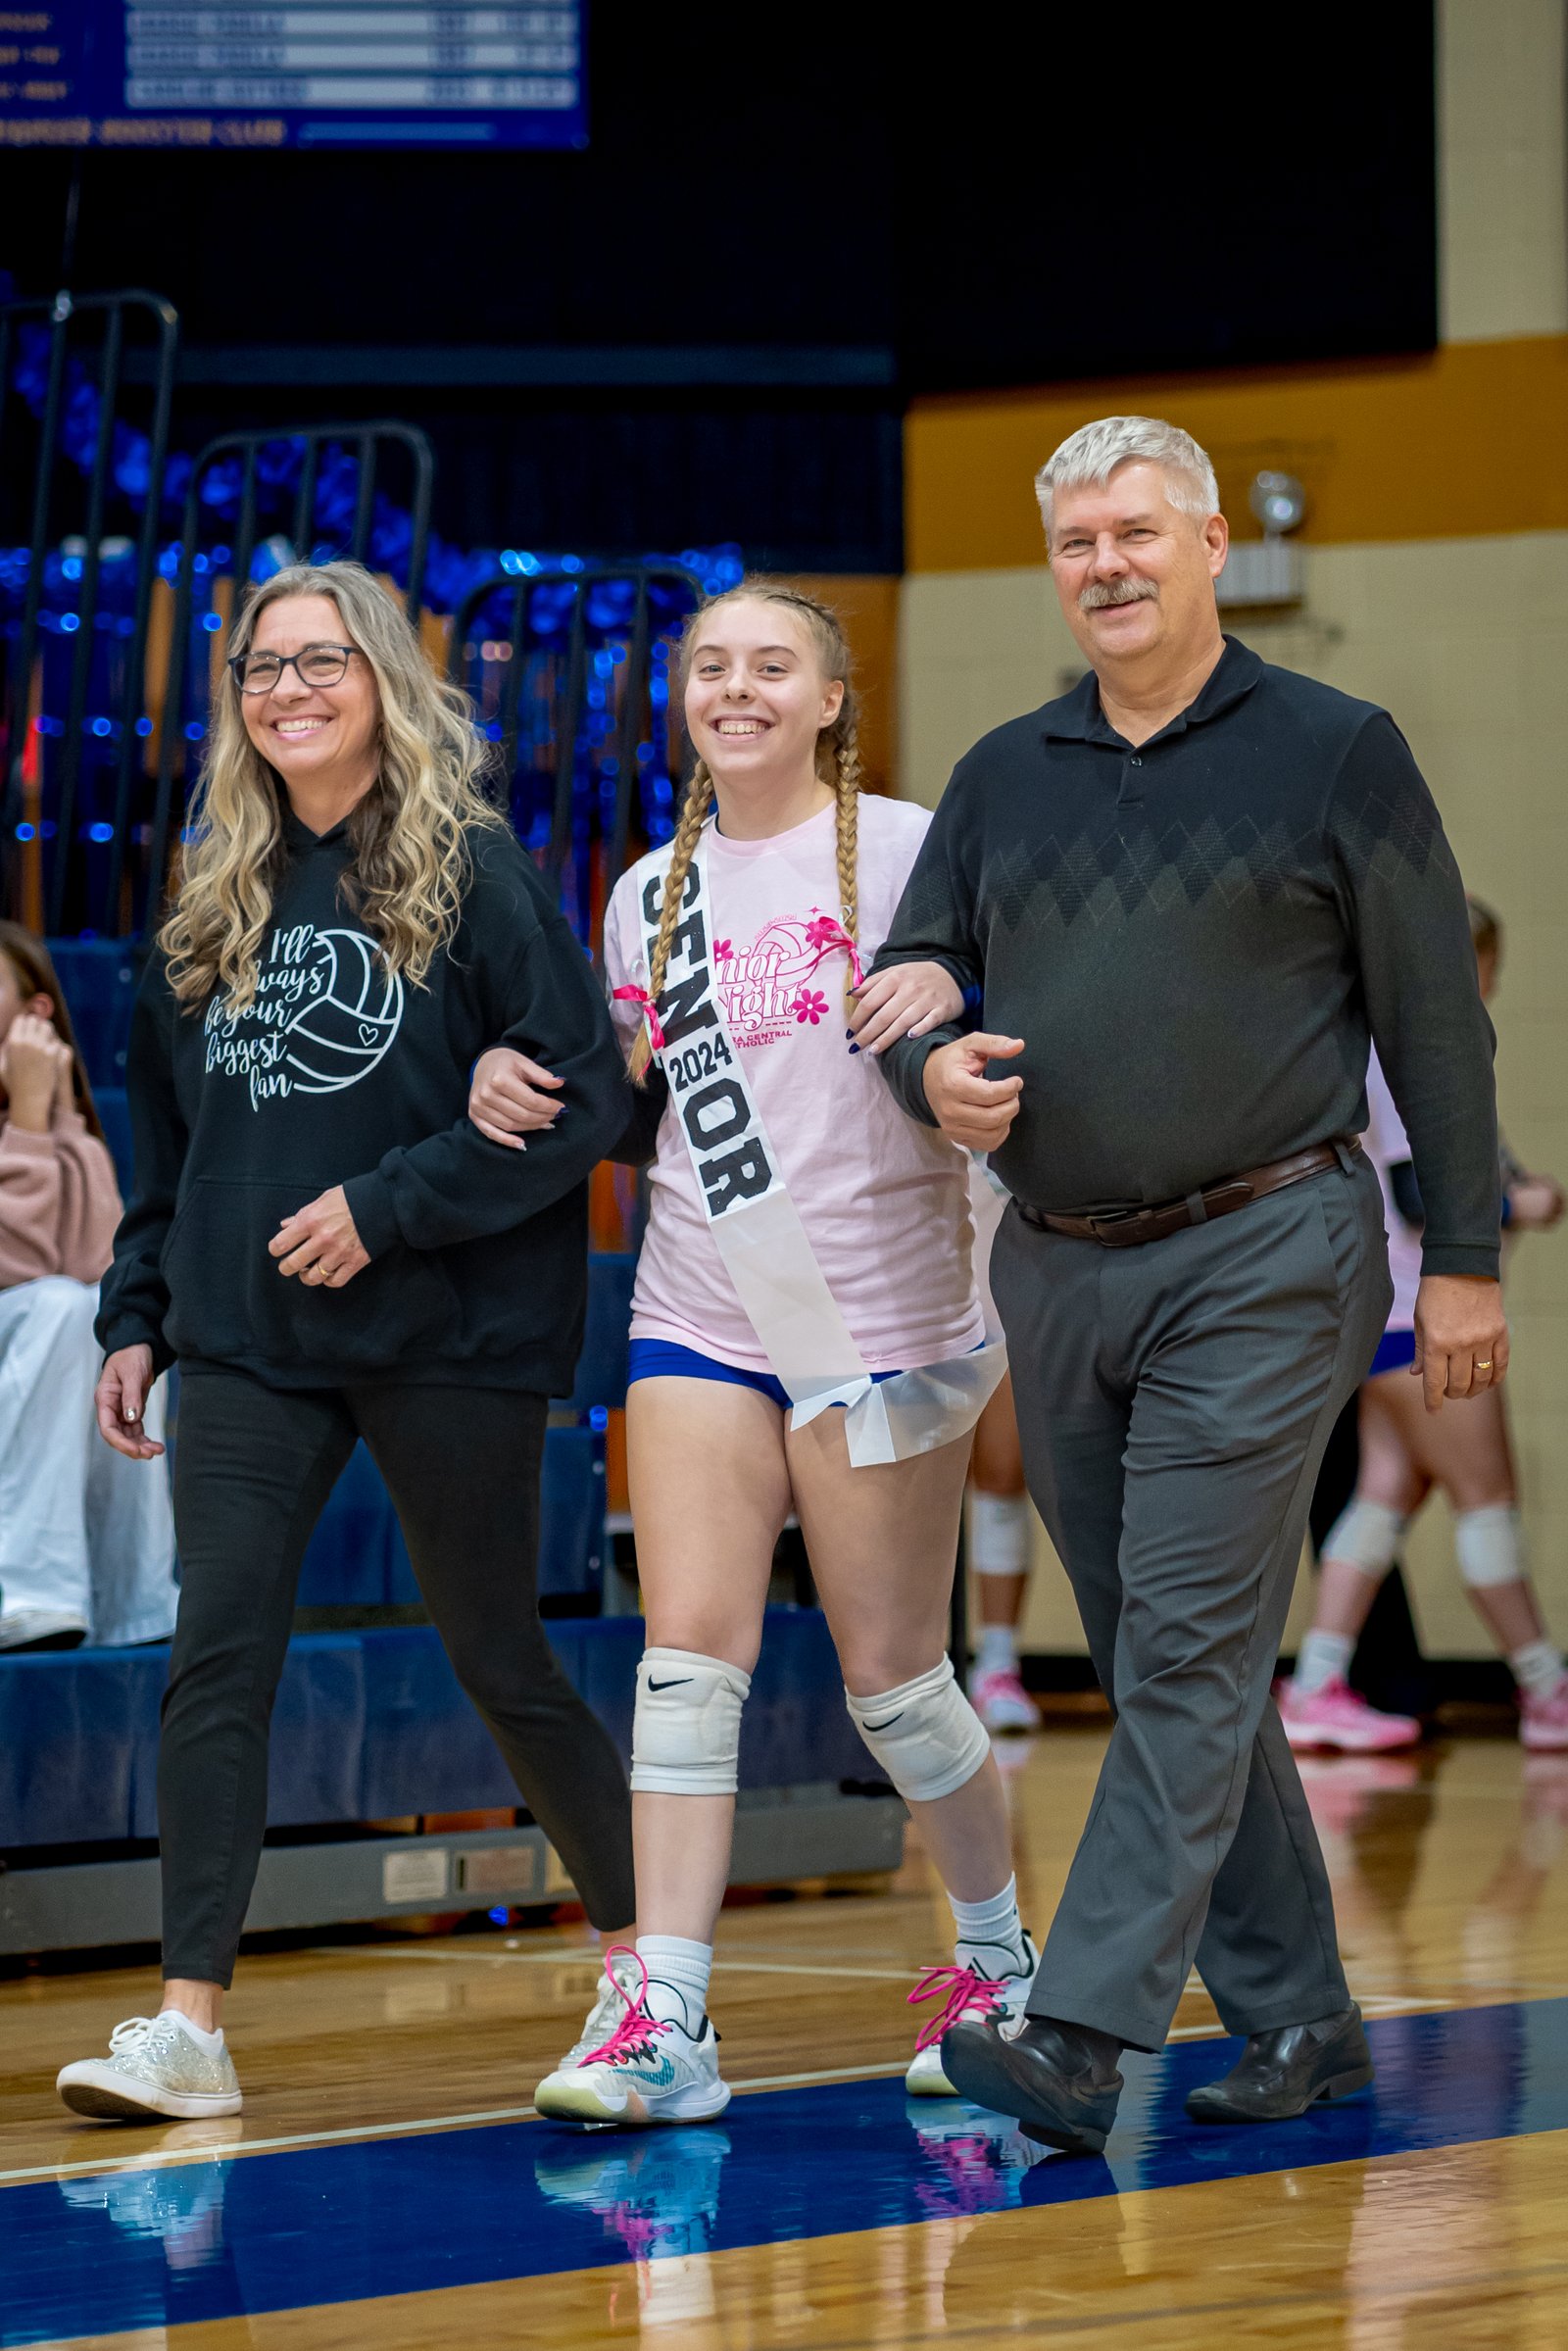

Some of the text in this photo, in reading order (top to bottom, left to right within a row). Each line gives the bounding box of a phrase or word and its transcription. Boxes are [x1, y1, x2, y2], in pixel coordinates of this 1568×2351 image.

[269, 924, 314, 964] I'll
[232, 959, 324, 1003] ways
[715, 946, 791, 984] nior
[221, 1000, 292, 1038] your
[747, 1030, 792, 1041] CENTRAL
[206, 1031, 287, 1076] biggest
[669, 1032, 733, 1092] 2024
[735, 1038, 774, 1049] THOLIC
[250, 1065, 292, 1112] fan
